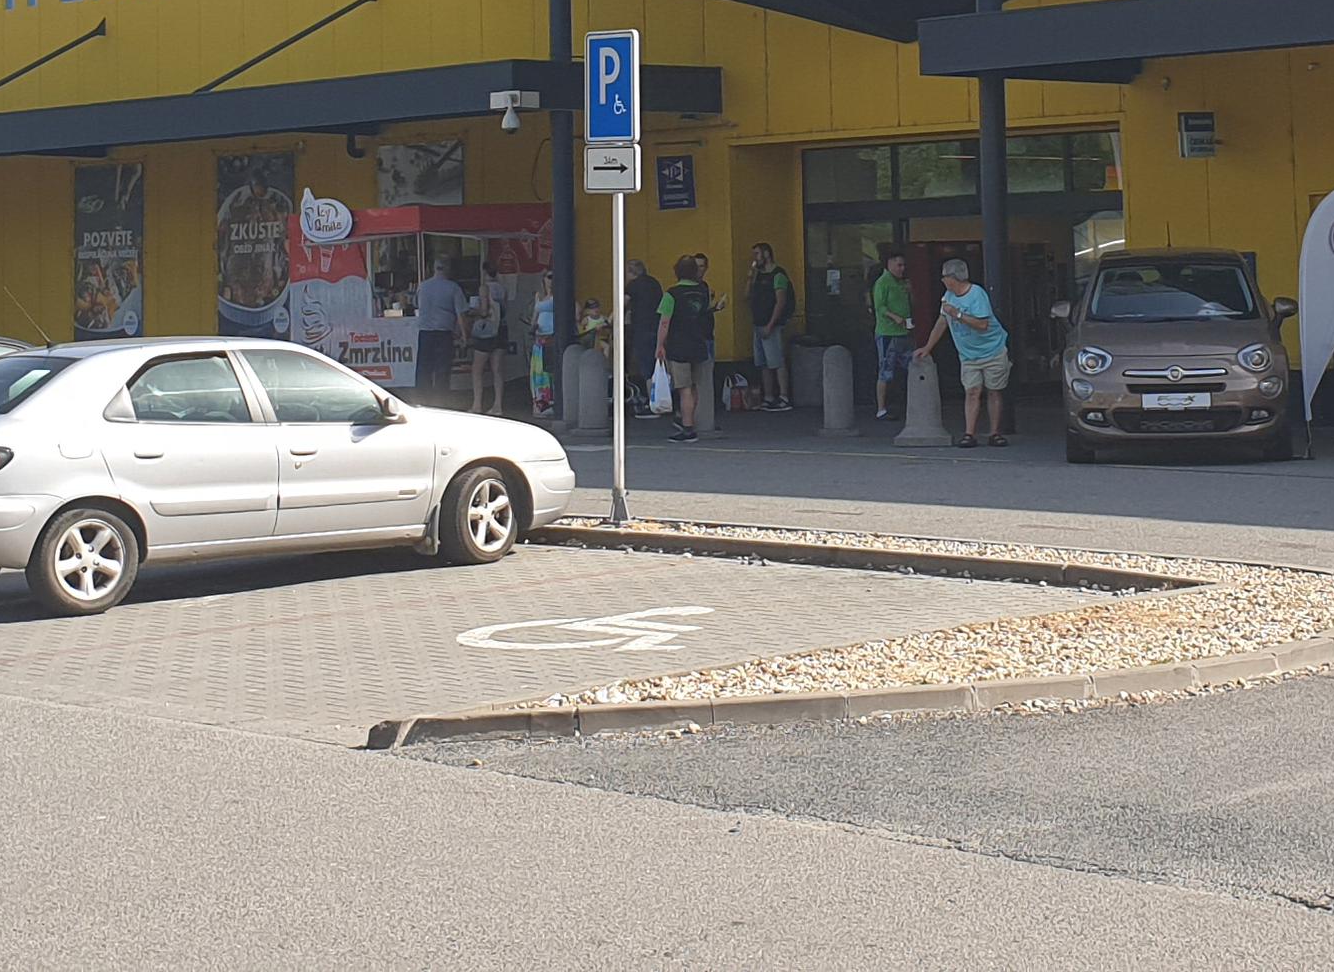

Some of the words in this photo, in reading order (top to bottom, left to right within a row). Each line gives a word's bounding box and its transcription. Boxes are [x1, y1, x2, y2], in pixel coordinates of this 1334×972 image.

[599, 47, 620, 105] P
[83, 226, 133, 248] POZVĚTE
[338, 339, 414, 364] Zmrzlina
